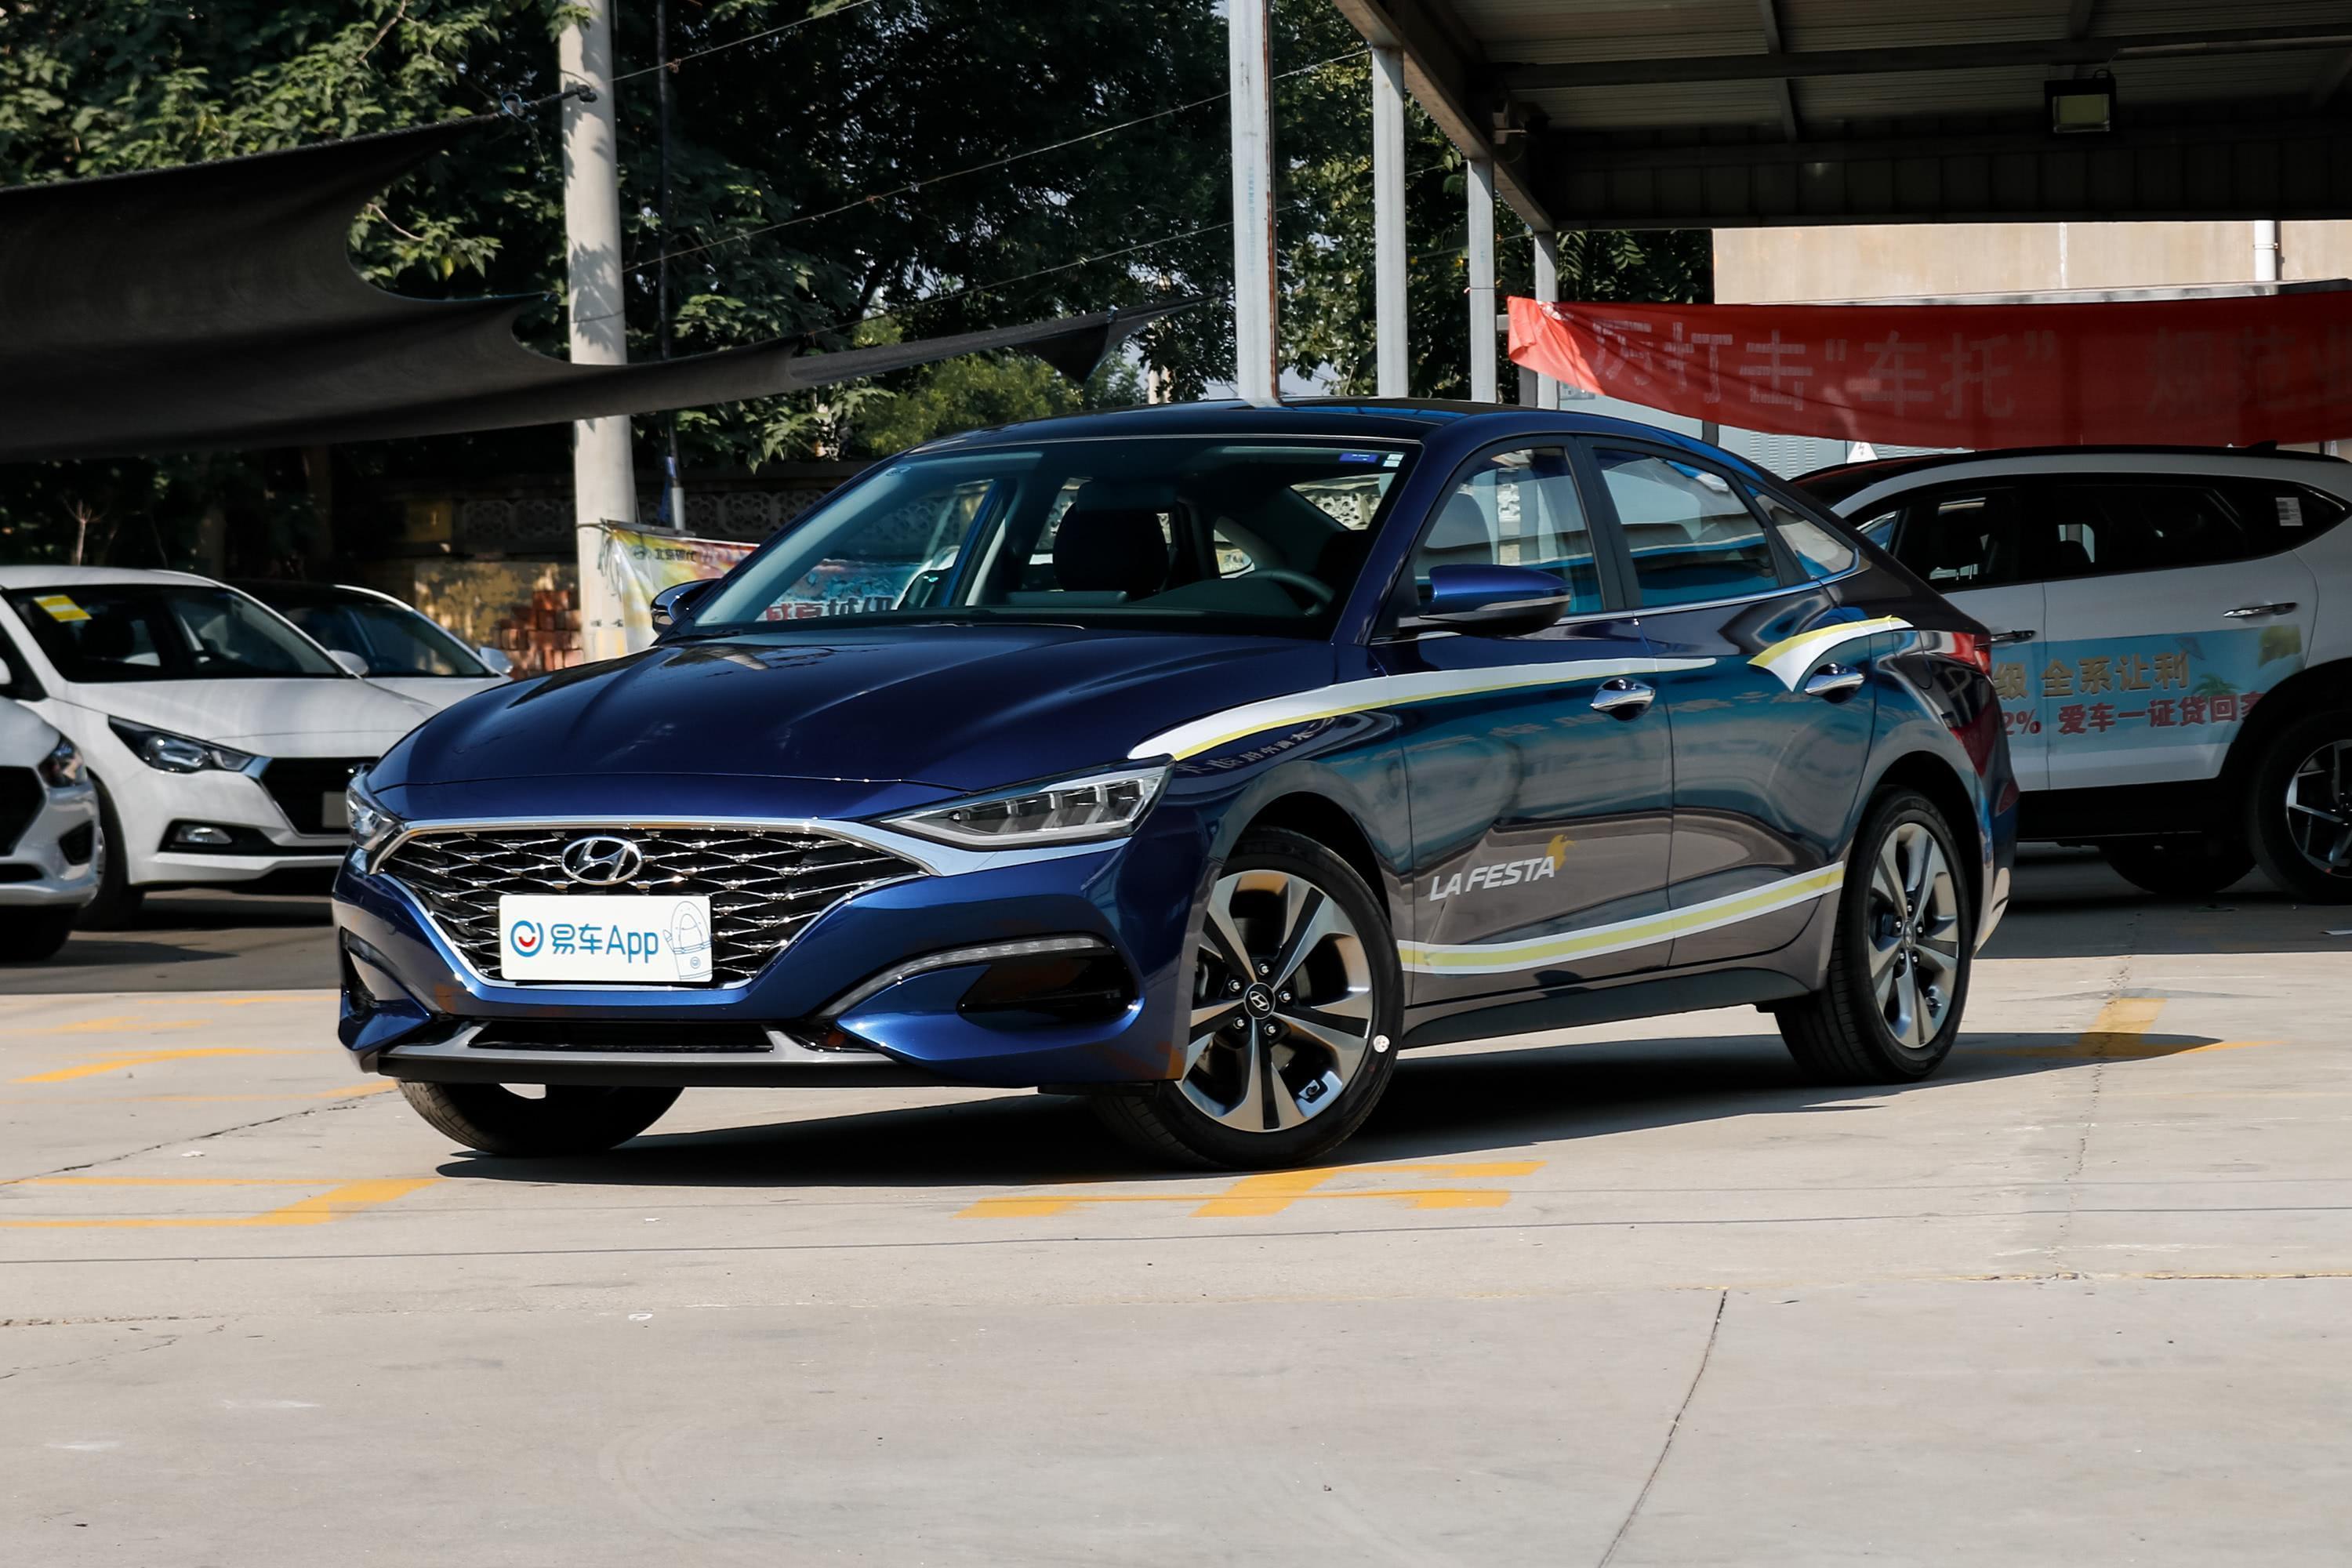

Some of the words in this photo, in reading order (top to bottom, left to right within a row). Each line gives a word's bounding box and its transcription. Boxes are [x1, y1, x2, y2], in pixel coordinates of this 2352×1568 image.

[2041, 652, 2189, 698] 全系让利
[1430, 873, 1461, 902] LA
[1465, 856, 1555, 892] FESTA
[550, 924, 659, 964] 易车App
